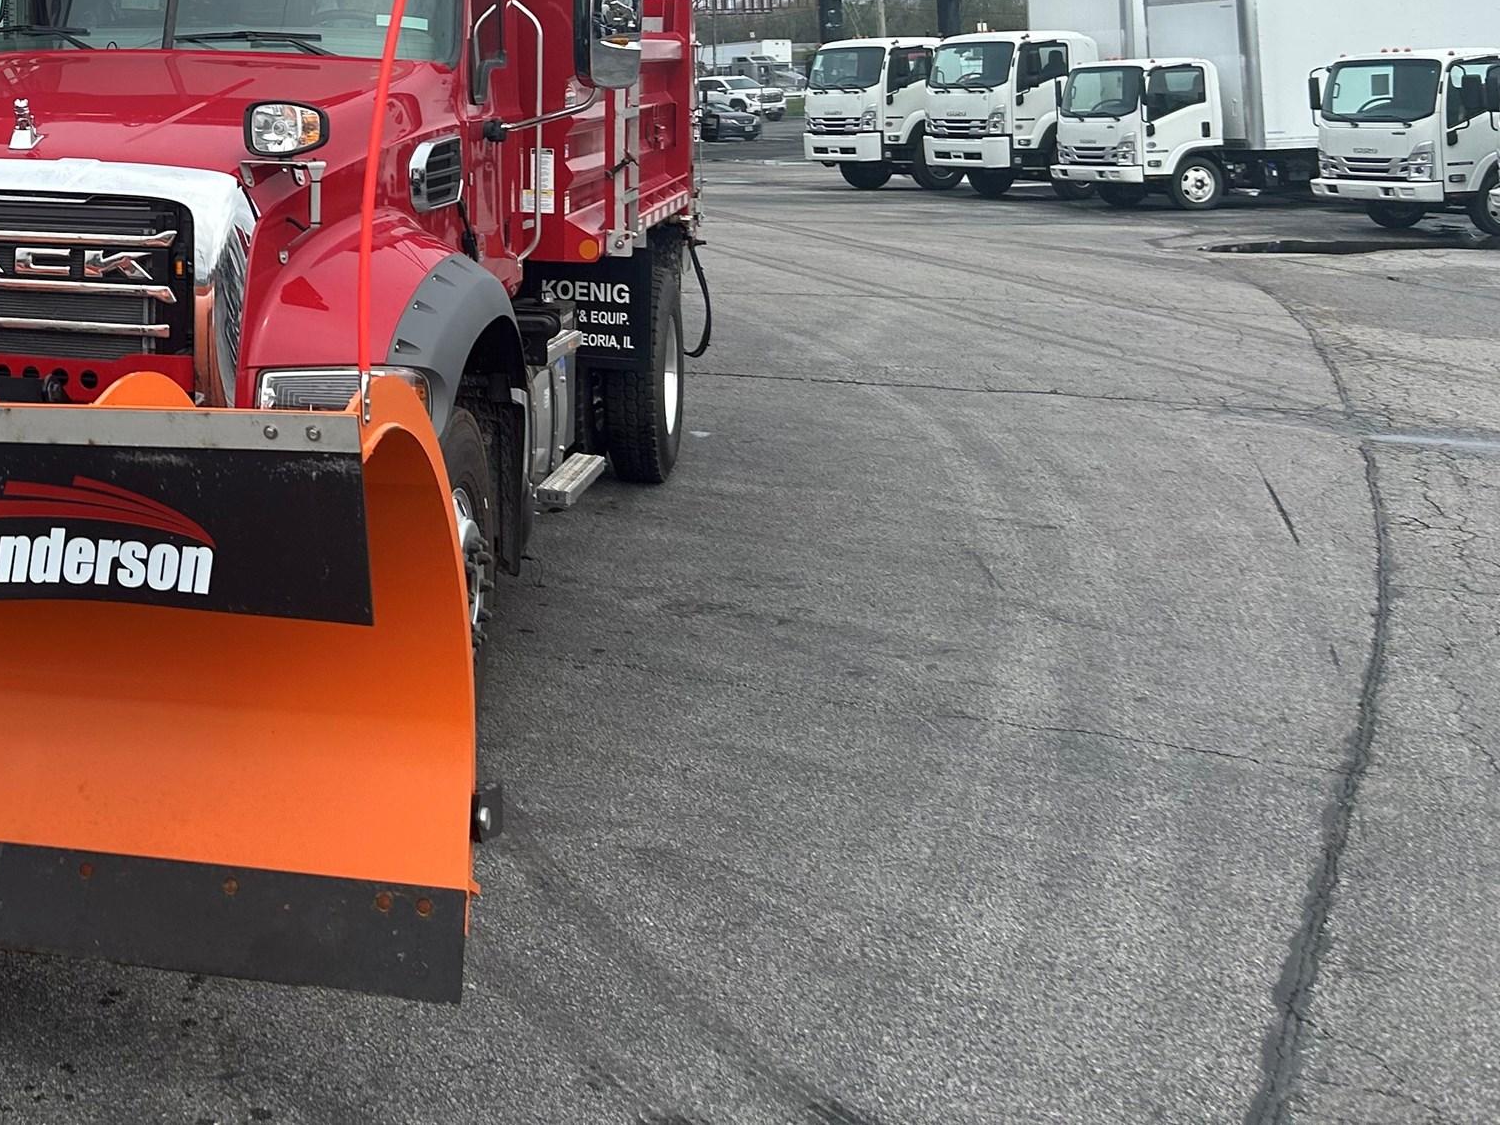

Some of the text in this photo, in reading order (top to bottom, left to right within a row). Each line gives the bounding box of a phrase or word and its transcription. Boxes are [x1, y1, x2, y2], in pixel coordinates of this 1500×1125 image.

[541, 279, 631, 304] KOENIG
[590, 310, 631, 326] EQUIP.
[580, 332, 636, 350] EORIA, IL
